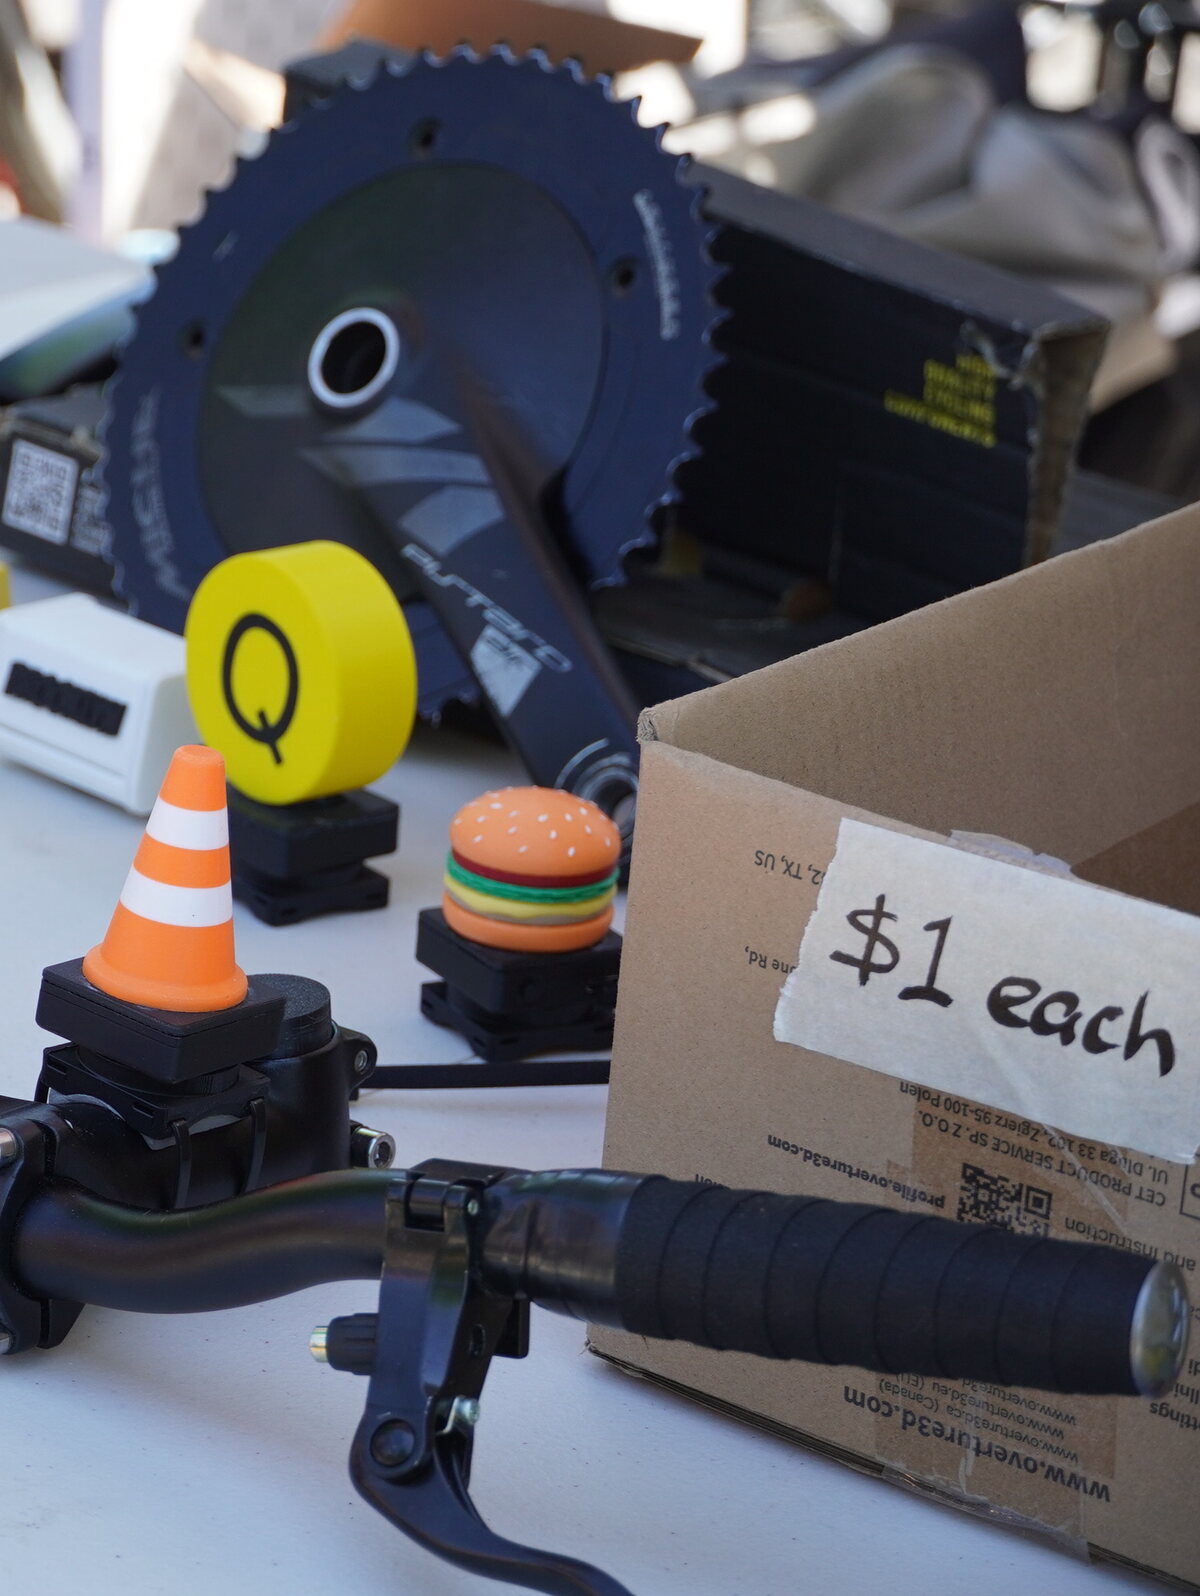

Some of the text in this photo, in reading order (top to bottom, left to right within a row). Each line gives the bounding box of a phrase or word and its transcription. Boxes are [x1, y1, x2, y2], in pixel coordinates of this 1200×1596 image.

[222, 612, 299, 765] Q
[754, 850, 776, 871] US
[781, 855, 803, 880] TX,
[745, 945, 768, 969] Rd,
[829, 894, 1176, 1077] $1 each
[899, 1081, 941, 1108] Polen
[918, 1110, 949, 1133] O.O.
[944, 1097, 992, 1125] 95-100
[951, 1122, 963, 1139] Z
[965, 1127, 989, 1147] SP.
[995, 1115, 1040, 1142] Zgierz
[992, 1135, 1054, 1171] SERVICE
[1078, 1143, 1097, 1160] 33
[767, 1134, 946, 1209] profile.overture3d.com
[1056, 1160, 1133, 1196] PRODUCT
[1133, 1186, 1167, 1207] CET
[879, 1378, 1079, 1463] www.overture3d.ca (Canada)
[932, 1381, 1065, 1440] www.overture3d.eu
[844, 1386, 1111, 1503] www.overture3d.com
